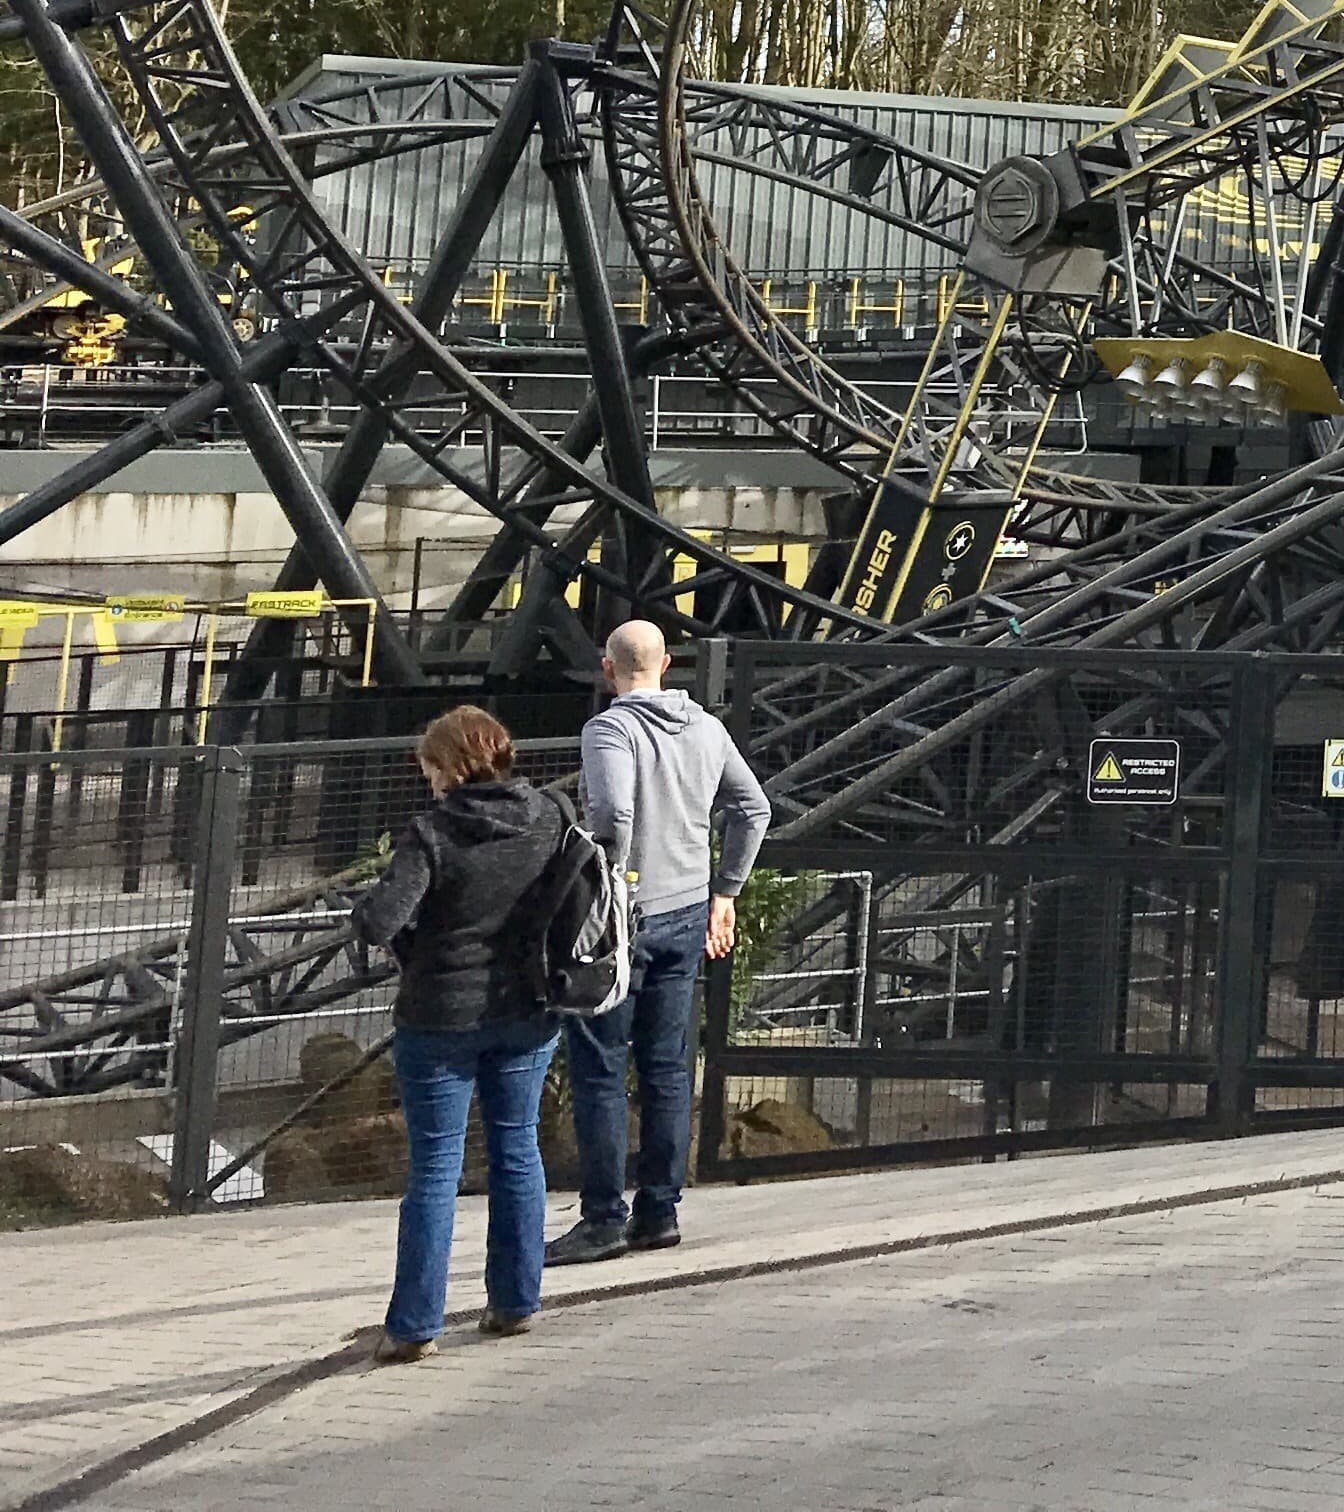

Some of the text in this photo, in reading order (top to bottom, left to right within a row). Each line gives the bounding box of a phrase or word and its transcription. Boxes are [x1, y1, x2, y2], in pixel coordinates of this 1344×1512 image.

[250, 599, 317, 610] FASTRACK
[1122, 758, 1175, 767] RESTRICTED
[1130, 767, 1166, 776] ACCESS
